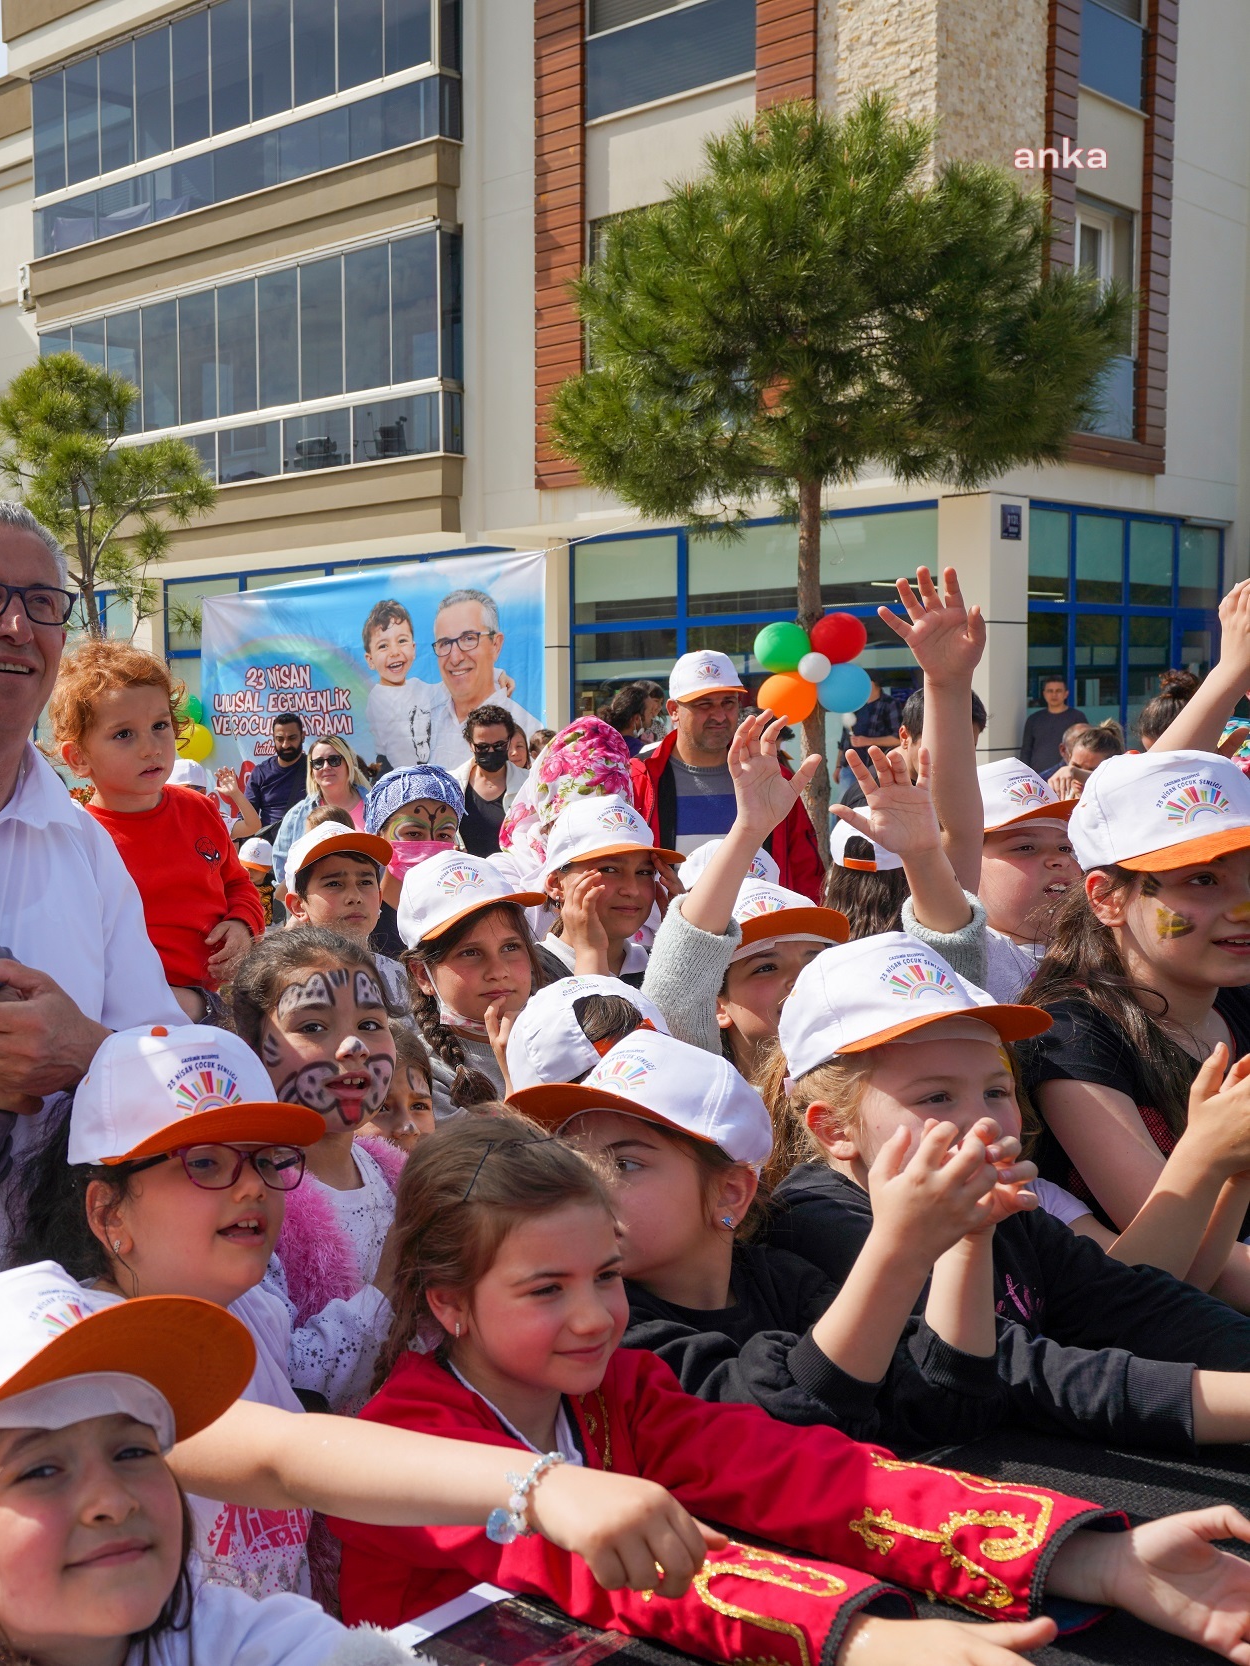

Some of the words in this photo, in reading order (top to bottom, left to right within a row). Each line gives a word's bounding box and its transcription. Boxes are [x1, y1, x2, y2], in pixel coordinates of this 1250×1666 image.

[245, 665, 267, 690] 23
[266, 663, 311, 691] NİSAN
[266, 687, 352, 714] EGEMENLİK
[211, 714, 231, 735] VE
[231, 713, 276, 738] ÇOCU
[301, 712, 354, 736] AYRAMI
